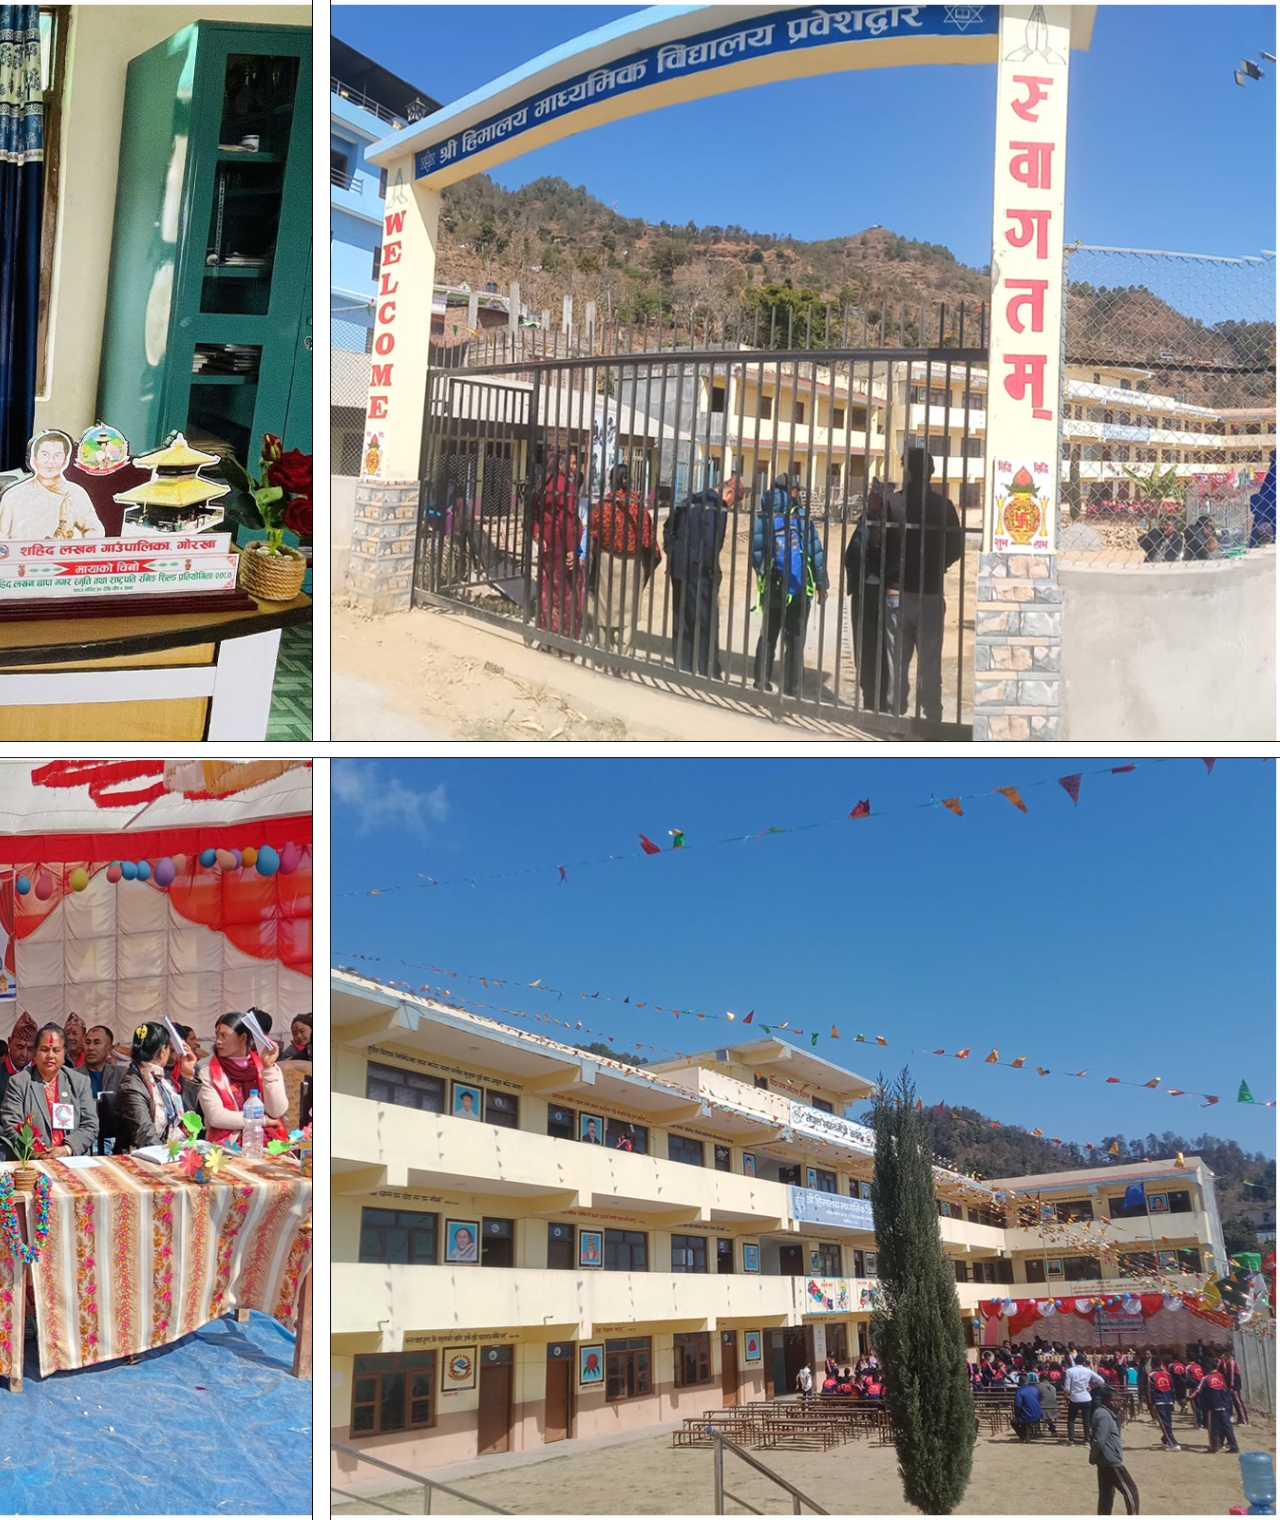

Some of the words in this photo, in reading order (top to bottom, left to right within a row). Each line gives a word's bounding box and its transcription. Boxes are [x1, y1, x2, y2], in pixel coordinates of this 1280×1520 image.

[439, 138, 458, 164] श्री
[462, 106, 530, 152] हिमालय
[534, 59, 648, 118] माध्यमिक
[656, 24, 776, 74] विद्यालय
[787, 5, 927, 44] प्रवेशद्वार
[368, 210, 406, 419] WELCOME
[1003, 74, 1054, 420] स्वागतम्
[20, 543, 56, 556] शहिद
[59, 544, 96, 554] लखन
[176, 538, 216, 550] गोरखा
[75, 562, 113, 574] मायाको
